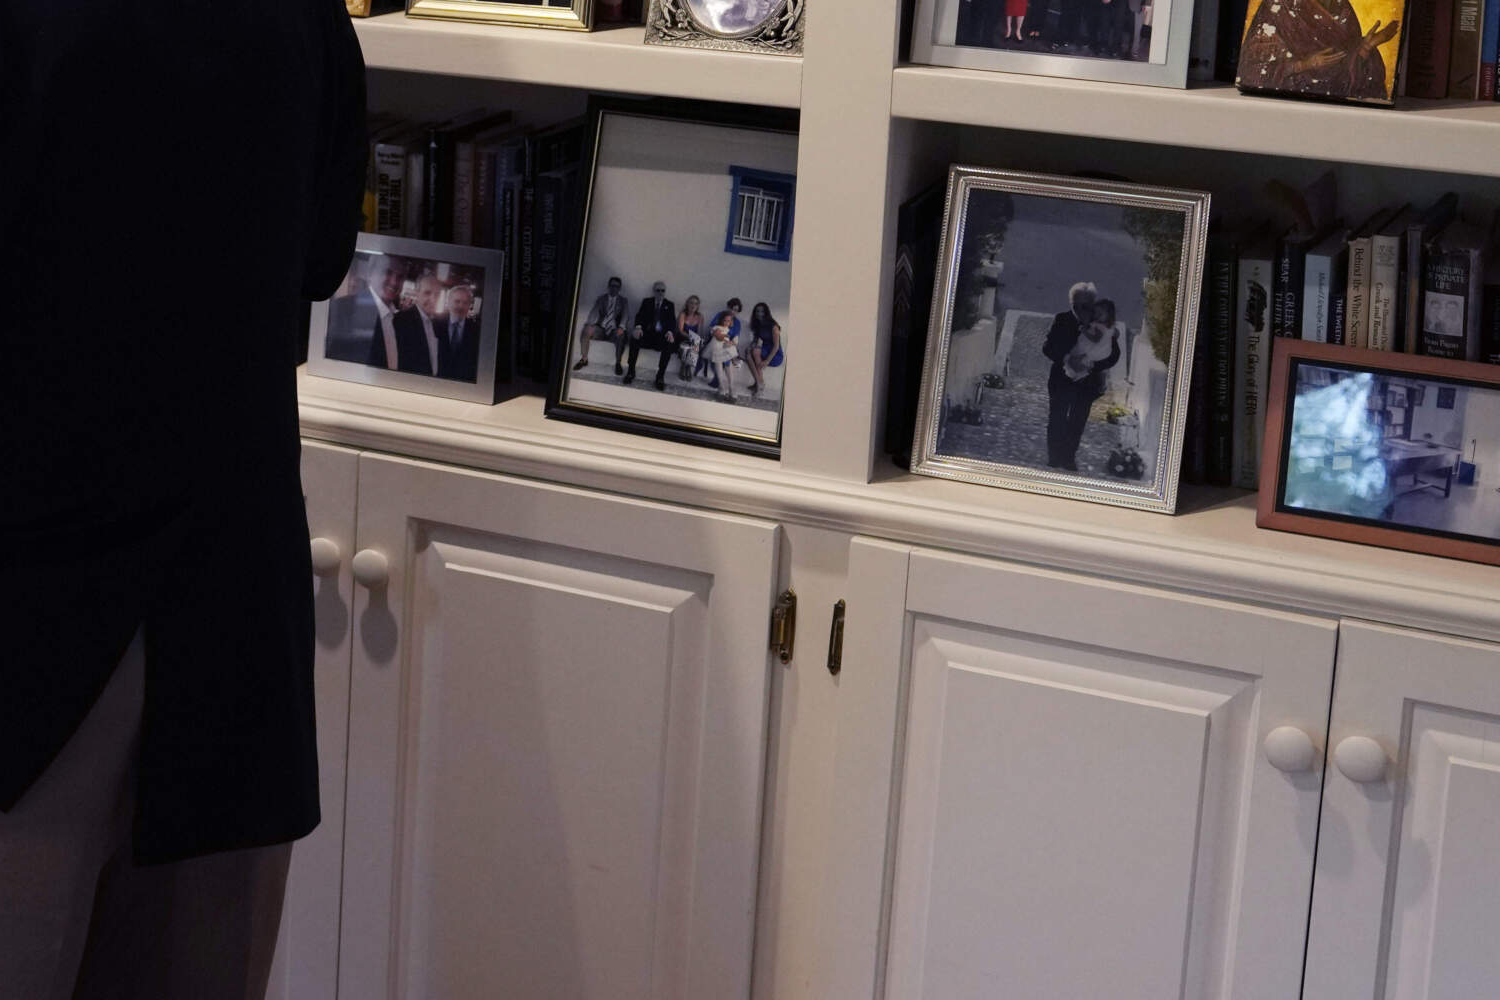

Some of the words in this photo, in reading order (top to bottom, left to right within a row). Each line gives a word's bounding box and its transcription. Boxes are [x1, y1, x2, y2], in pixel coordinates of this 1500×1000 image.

[1459, 6, 1478, 32] Mead
[1353, 247, 1364, 277] Behind
[1352, 278, 1362, 292] the
[1374, 282, 1384, 304] Greek
[1435, 281, 1451, 290] LIFE
[1284, 292, 1296, 331] GREEK
[1351, 294, 1363, 319] White
[1373, 306, 1382, 318] and
[1249, 335, 1260, 350] The
[1350, 320, 1361, 348] Screen
[1372, 319, 1382, 345] Roman
[1246, 353, 1260, 379] Glory
[1247, 380, 1257, 390] of
[1246, 392, 1258, 417] HERA
